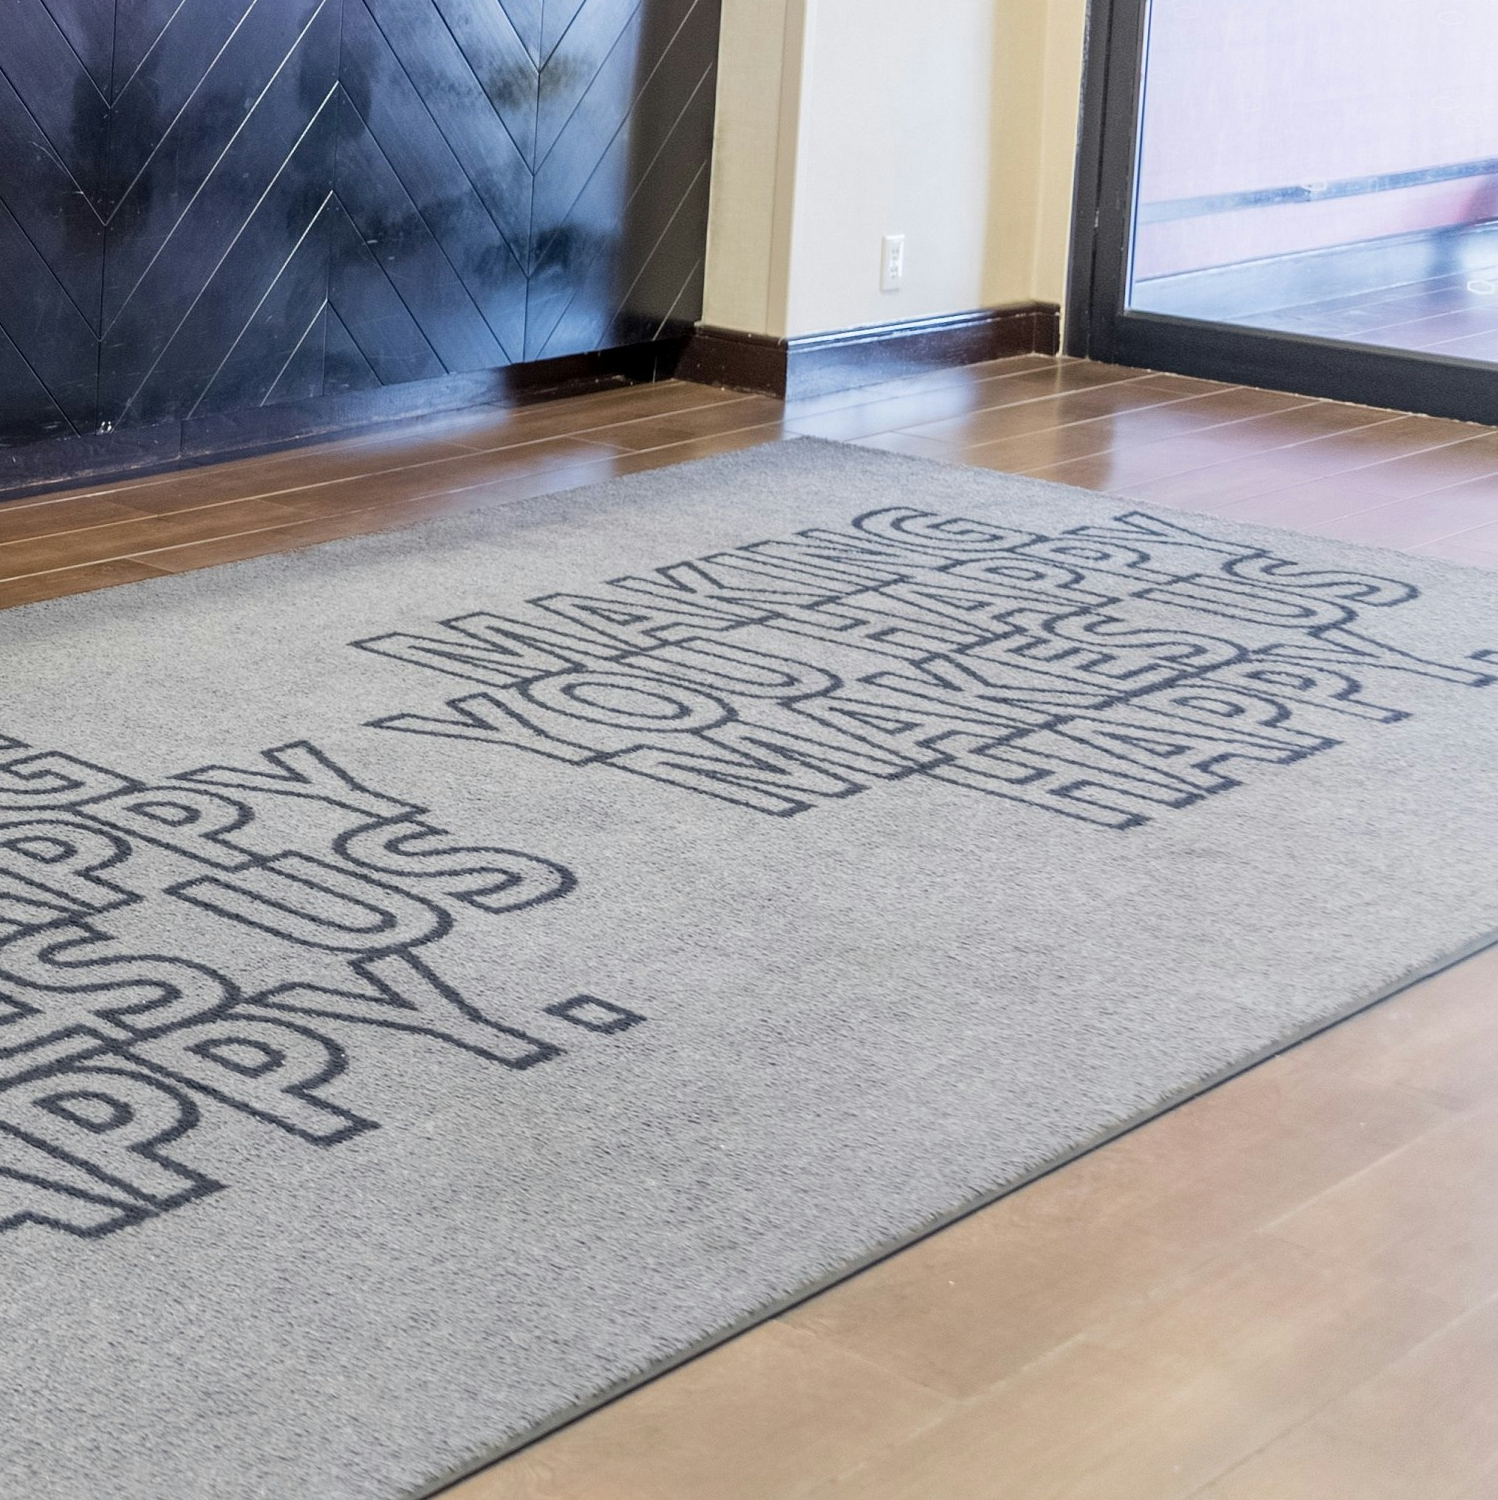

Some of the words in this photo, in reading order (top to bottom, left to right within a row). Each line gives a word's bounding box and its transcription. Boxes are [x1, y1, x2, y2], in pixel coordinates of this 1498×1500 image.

[347, 506, 1051, 688] MAKING
[361, 636, 846, 766] YOU
[763, 510, 1273, 664] HAPPY
[604, 606, 1253, 818] MAKES
[1132, 549, 1420, 630] US
[162, 816, 579, 954] US
